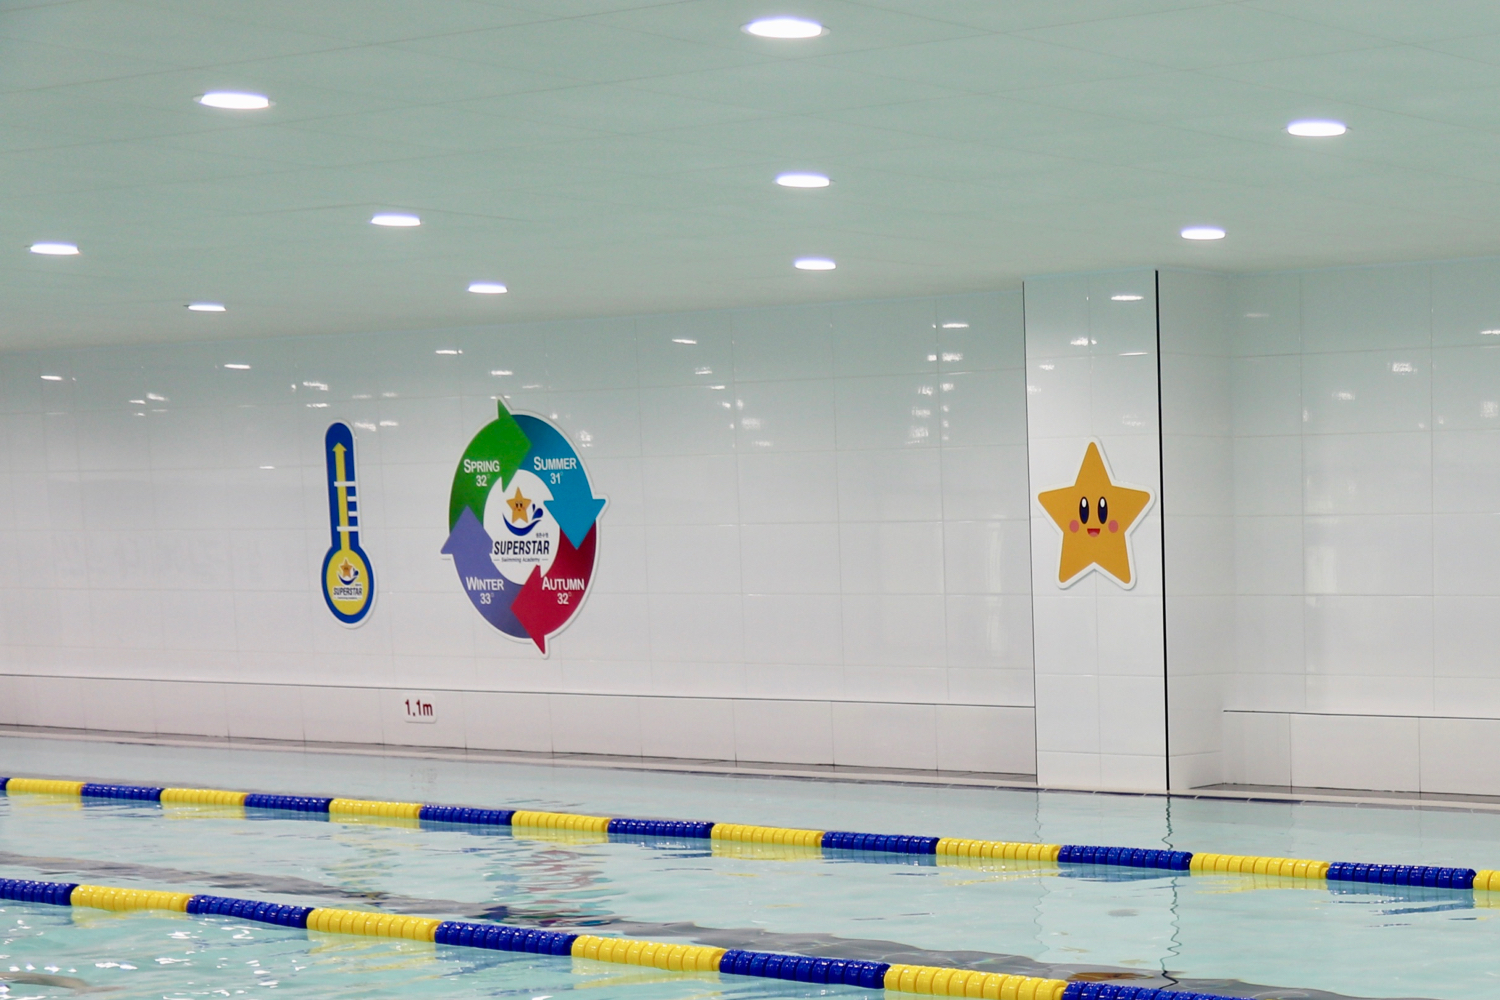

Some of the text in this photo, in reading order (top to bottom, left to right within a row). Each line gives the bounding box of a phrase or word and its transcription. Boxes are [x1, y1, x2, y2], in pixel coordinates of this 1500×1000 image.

[464, 459, 500, 473] SPRING
[533, 456, 577, 471] SUMMER
[493, 541, 550, 555] SUPERSTAR
[465, 576, 504, 591] WINTER
[541, 576, 585, 591] AUTUMN
[405, 699, 433, 717] 1.1m
